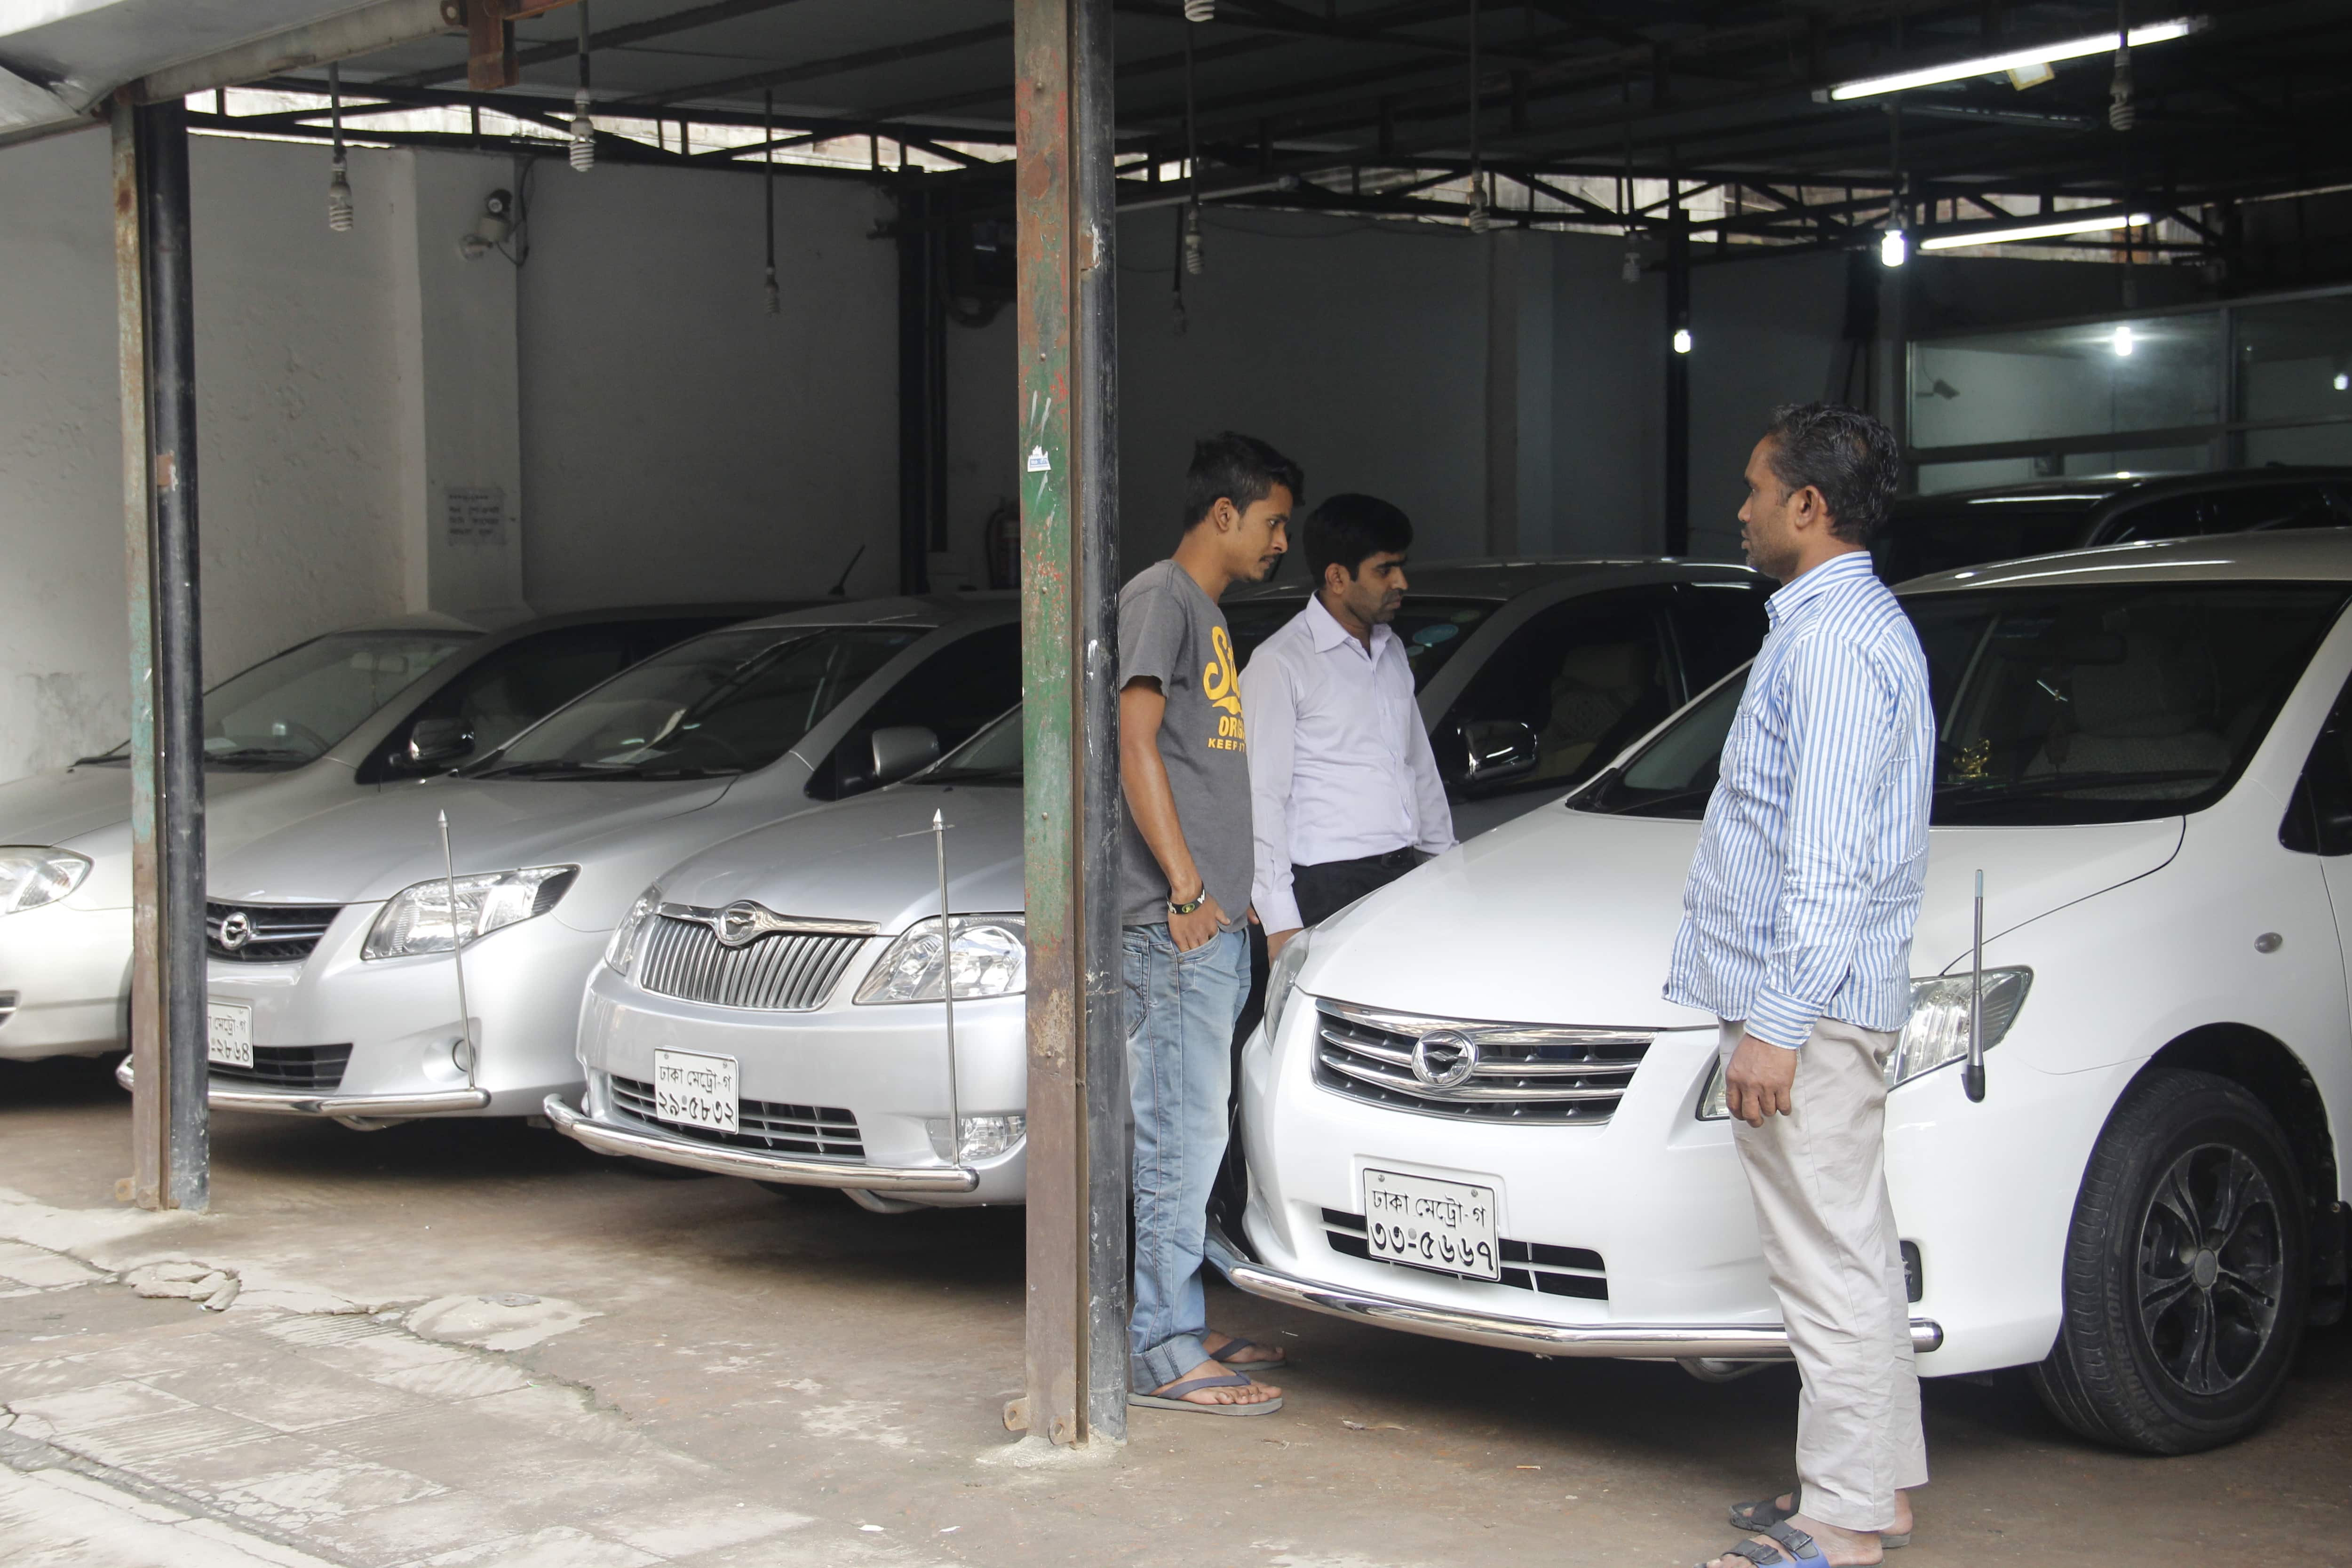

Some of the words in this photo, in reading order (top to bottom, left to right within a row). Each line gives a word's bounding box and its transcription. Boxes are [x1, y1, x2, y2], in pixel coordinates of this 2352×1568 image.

[1208, 738, 1238, 750] KEEP
[211, 1038, 250, 1062] -২৮৬৪
[659, 1066, 683, 1083] ঢাকা
[659, 1091, 735, 1126] ২৯-৫৮৩২
[1372, 1189, 1409, 1215] ঢাকা
[1370, 1222, 1494, 1271] ৩৩-৫৬৬৭
